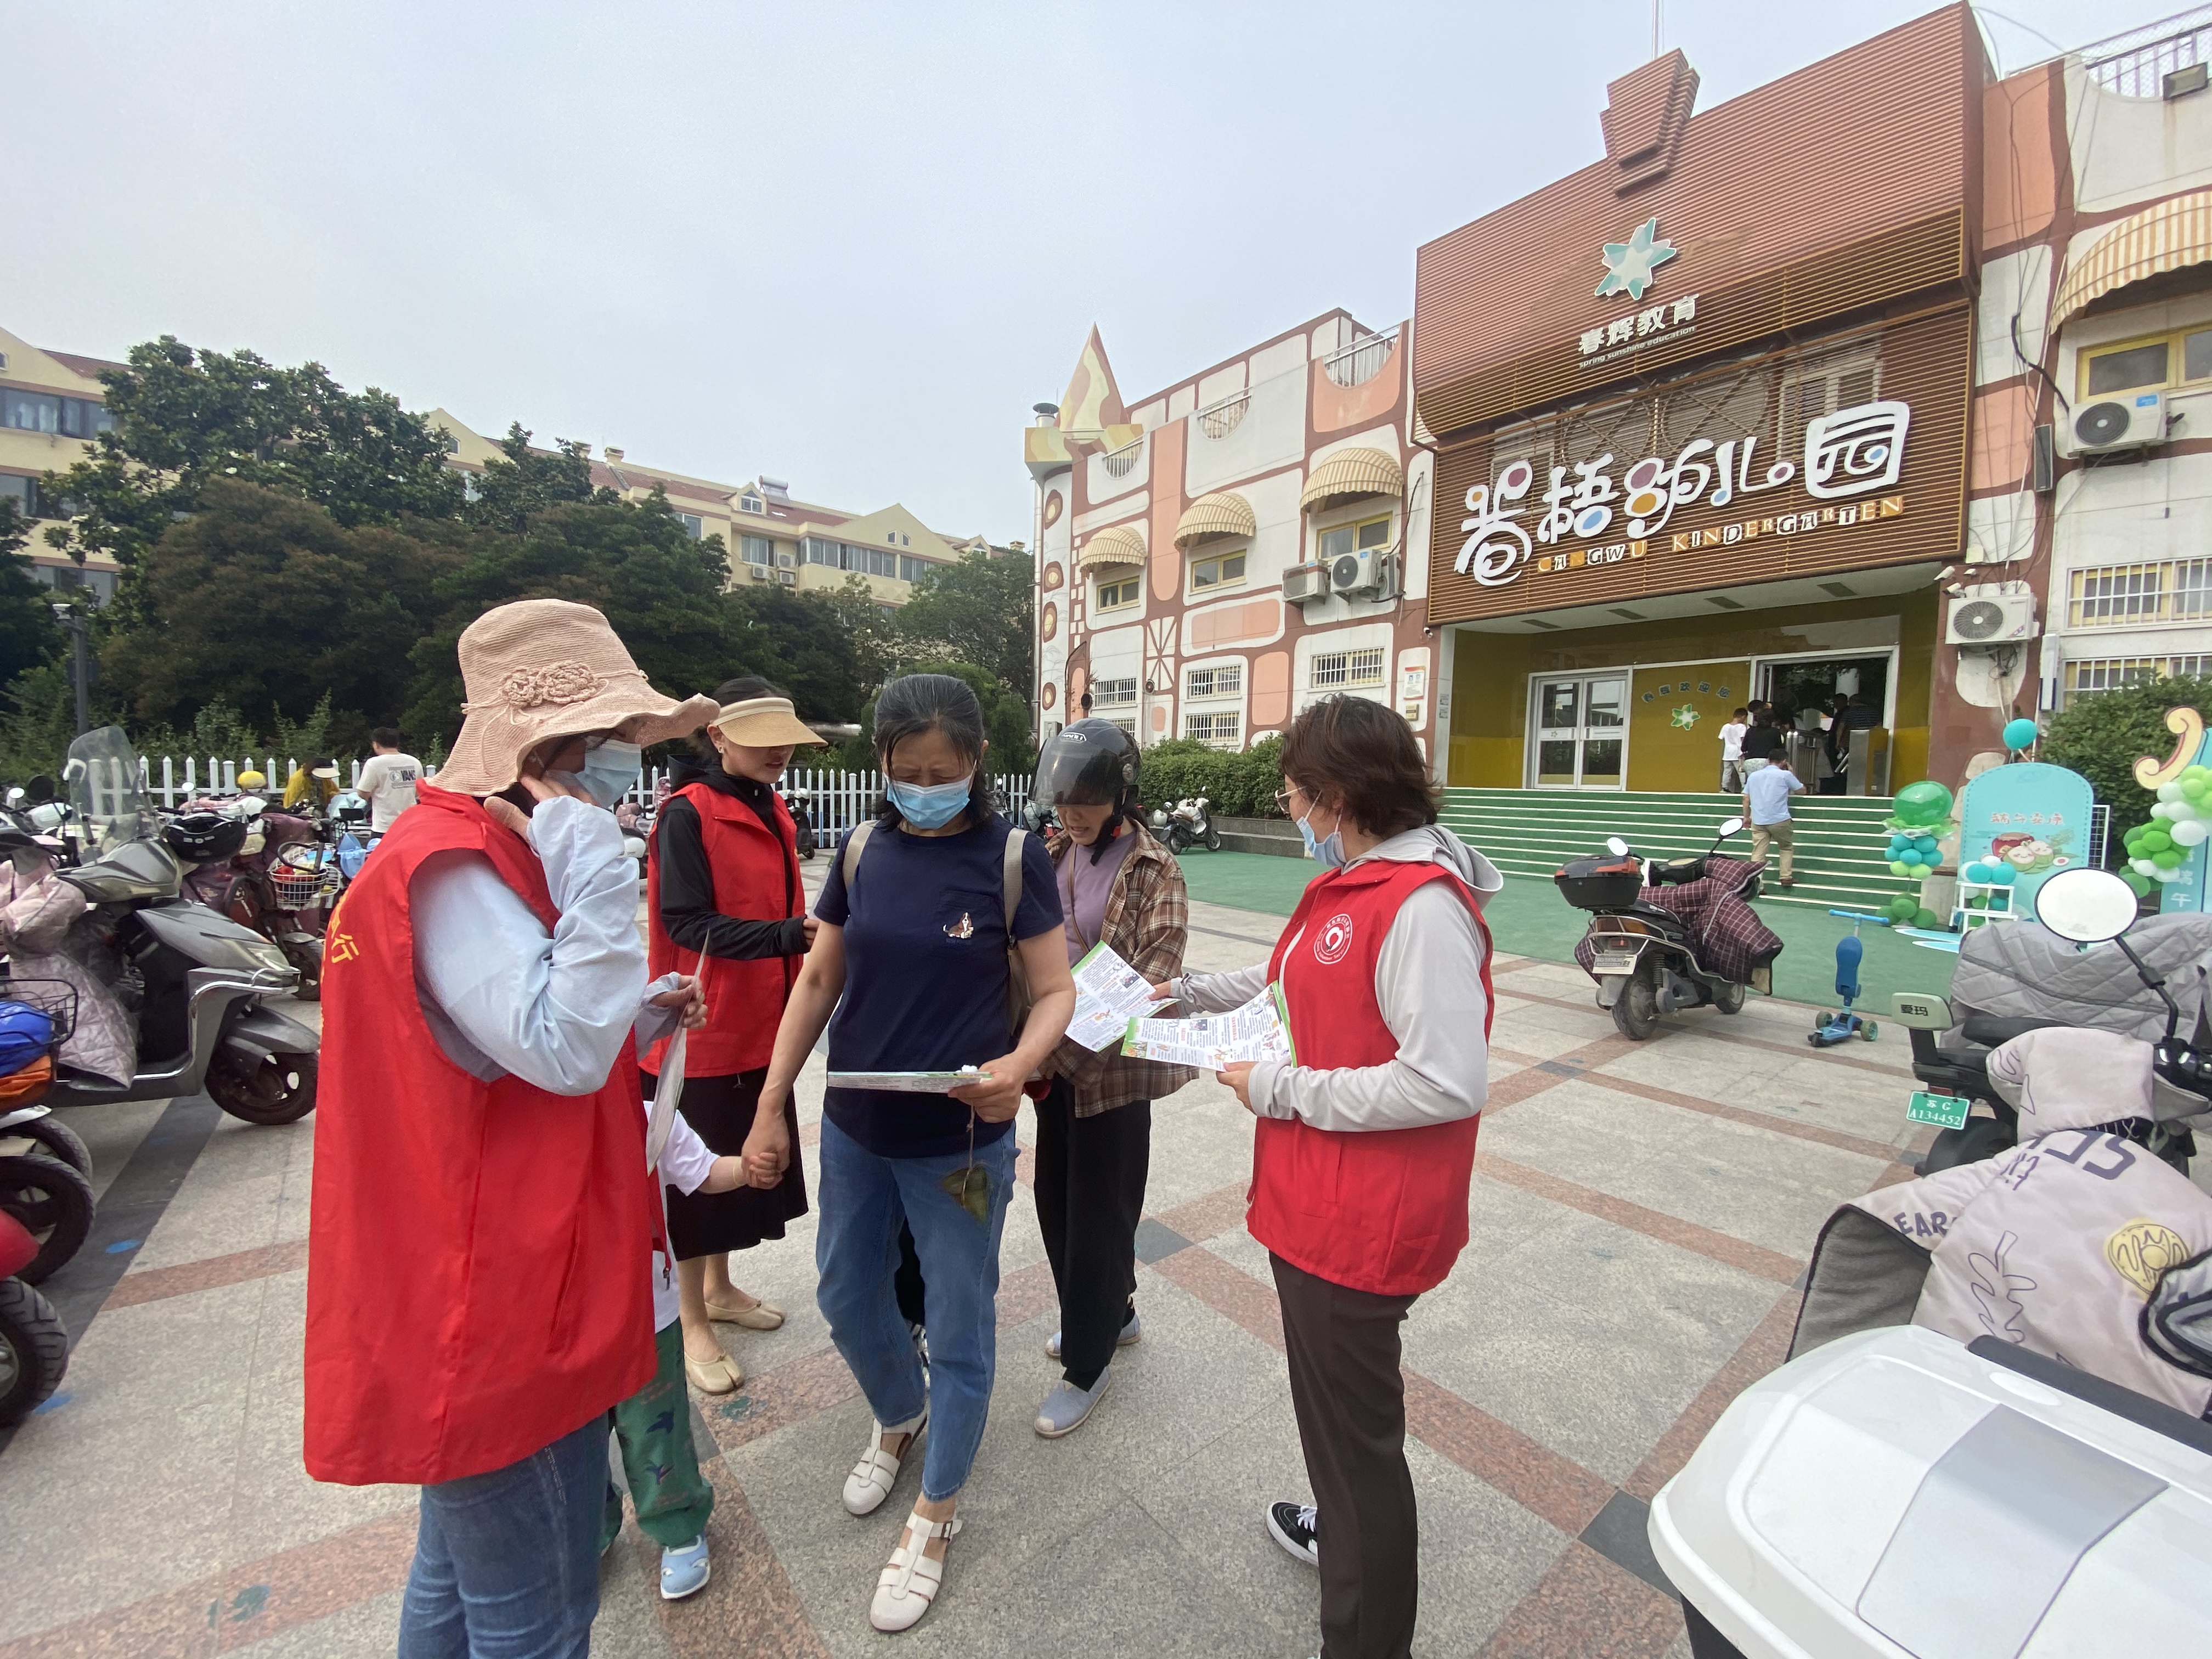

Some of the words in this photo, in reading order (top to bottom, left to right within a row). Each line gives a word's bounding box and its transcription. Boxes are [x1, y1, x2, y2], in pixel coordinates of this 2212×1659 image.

[1579, 354, 1605, 368] spring
[1607, 341, 1645, 359] sunshine
[1647, 326, 1695, 346] education
[1538, 539, 1648, 572] CANGWU
[1672, 495, 1904, 552] KINDERGARTEN
[1990, 811, 2065, 826] 端午安康
[1909, 1108, 1961, 1126] A134452
